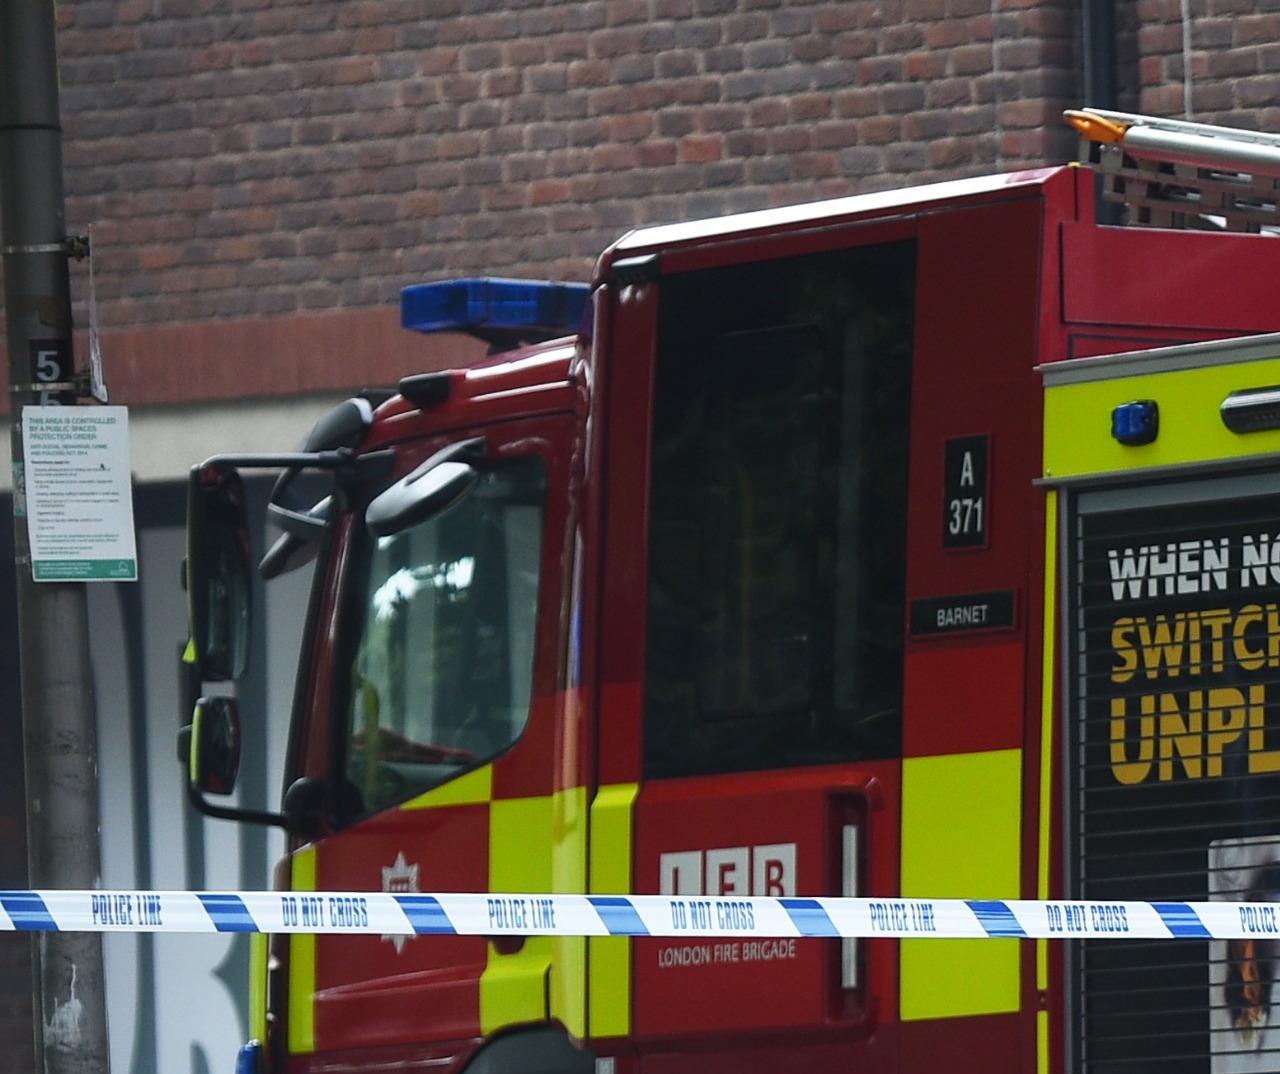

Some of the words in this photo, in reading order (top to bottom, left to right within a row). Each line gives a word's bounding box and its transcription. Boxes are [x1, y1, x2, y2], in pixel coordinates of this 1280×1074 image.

[37, 350, 60, 382] 5
[960, 451, 974, 487] A
[949, 497, 982, 535] 371
[1108, 538, 1229, 600] WHEN
[937, 605, 988, 627] BARNET
[91, 895, 133, 926] POLICE
[137, 895, 163, 926] LINE
[281, 896, 298, 927] DO
[301, 897, 325, 927] NOT
[328, 897, 368, 927] CROSS
[488, 899, 528, 929] POLICE
[531, 899, 556, 929] LINE
[671, 901, 687, 929] DO
[689, 901, 712, 929] NOT
[716, 901, 755, 930] CROSS
[869, 903, 908, 931] POLICE
[911, 904, 936, 931] LINE
[1046, 904, 1063, 932] DO
[1064, 905, 1088, 932] NOT
[1092, 905, 1129, 932] CROSS
[1238, 906, 1276, 933] POLICE
[659, 944, 710, 968] LONDON
[714, 942, 738, 962] FIRE
[743, 938, 796, 961] BRIGADE
